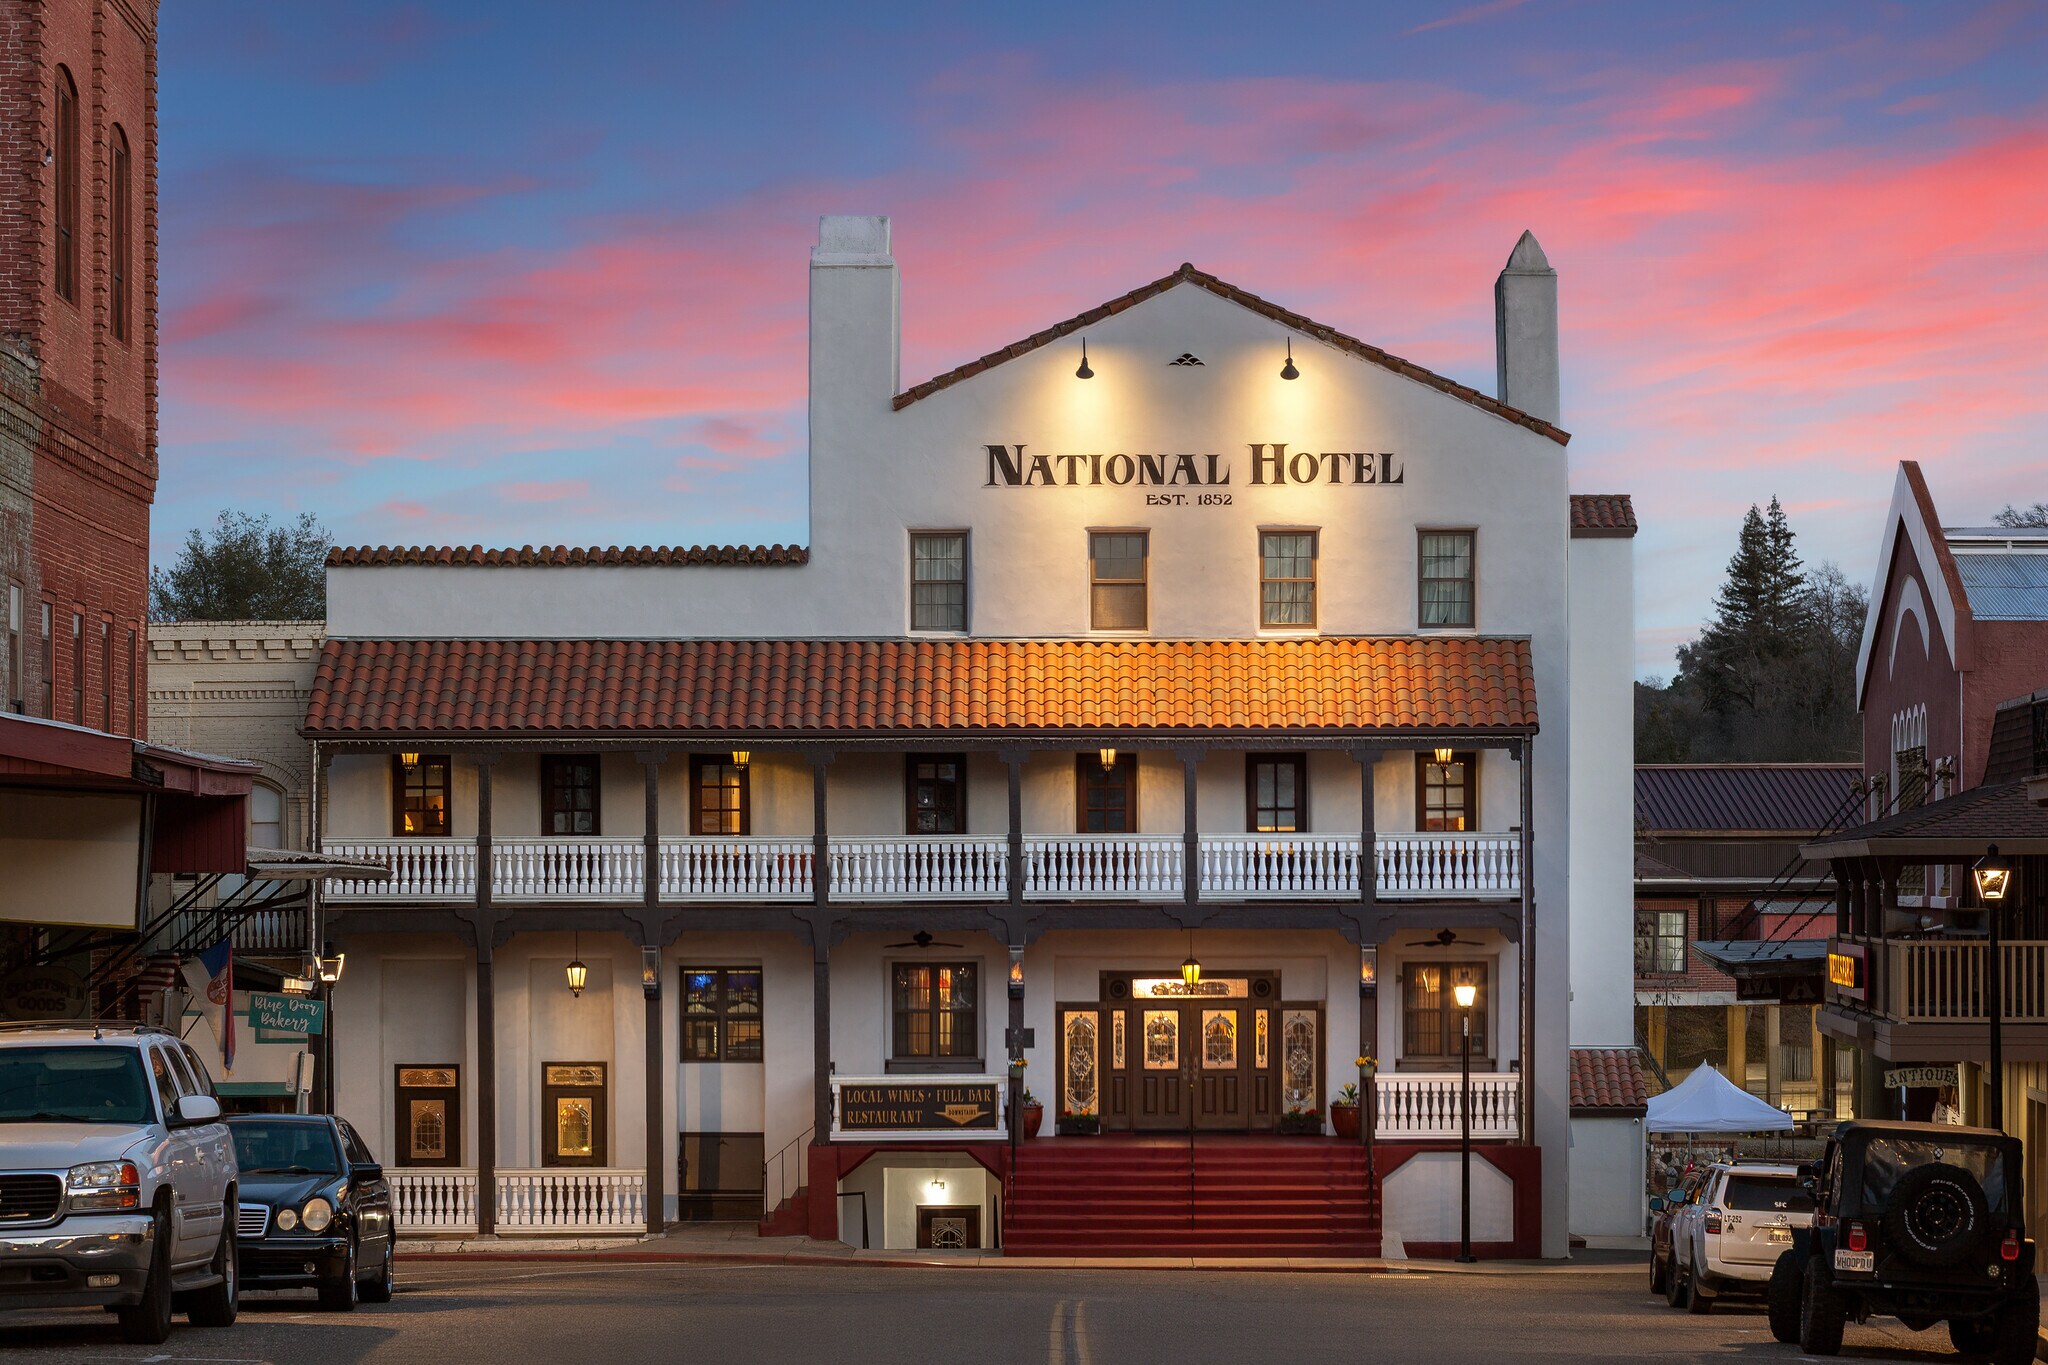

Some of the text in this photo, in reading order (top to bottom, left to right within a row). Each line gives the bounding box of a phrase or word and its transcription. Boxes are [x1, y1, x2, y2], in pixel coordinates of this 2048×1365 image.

[983, 443, 1405, 486] NATIONAL HOTEL
[1145, 494, 1233, 506] EST. 1852
[17, 996, 67, 1011] GOODS
[254, 996, 320, 1016] Blue Door
[260, 1010, 310, 1032] Bakery
[1889, 1069, 1959, 1086] ANTIQUES
[847, 1088, 991, 1104] LOCAL WINES FULL BAR
[847, 1110, 923, 1124] RESTAURANT
[1724, 1214, 1742, 1223] LT-252
